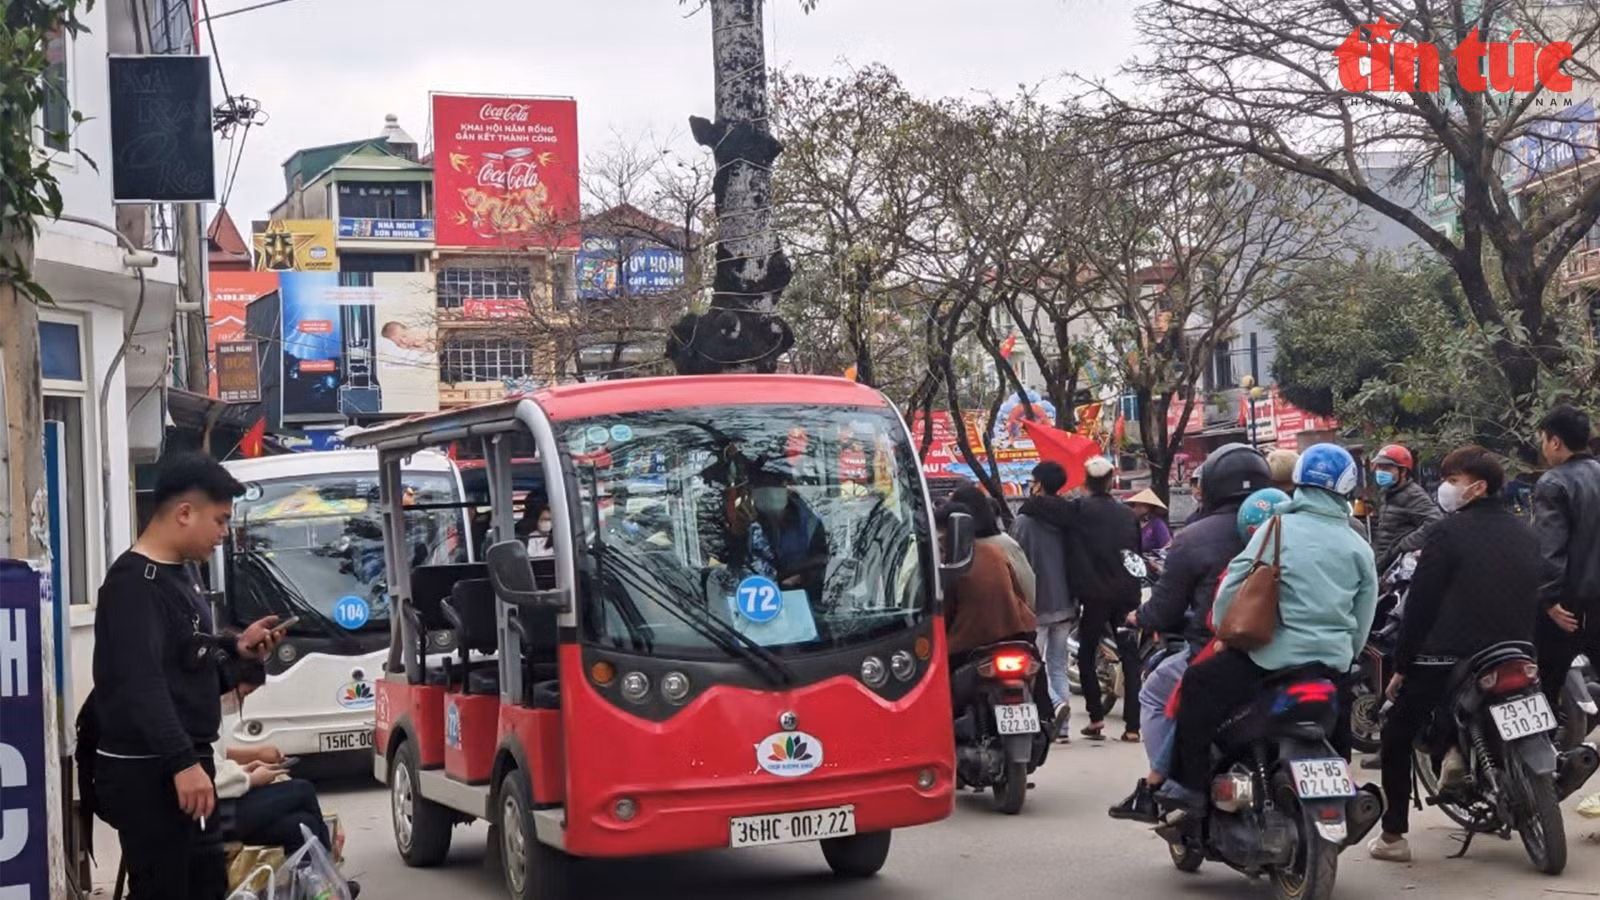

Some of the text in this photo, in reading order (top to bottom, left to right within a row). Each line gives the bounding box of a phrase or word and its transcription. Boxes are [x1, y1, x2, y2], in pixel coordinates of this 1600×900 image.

[460, 123, 484, 132] KHAI
[486, 123, 503, 133] HỘI
[532, 134, 558, 143] CÔNG
[740, 585, 777, 613] 72
[339, 604, 364, 621] 104
[1499, 697, 1538, 721] 29-Y7
[1000, 718, 1037, 733] 622.98
[1501, 711, 1550, 737] 510.37
[1299, 762, 1342, 778] 34-B5
[1299, 778, 1352, 796] 024.48
